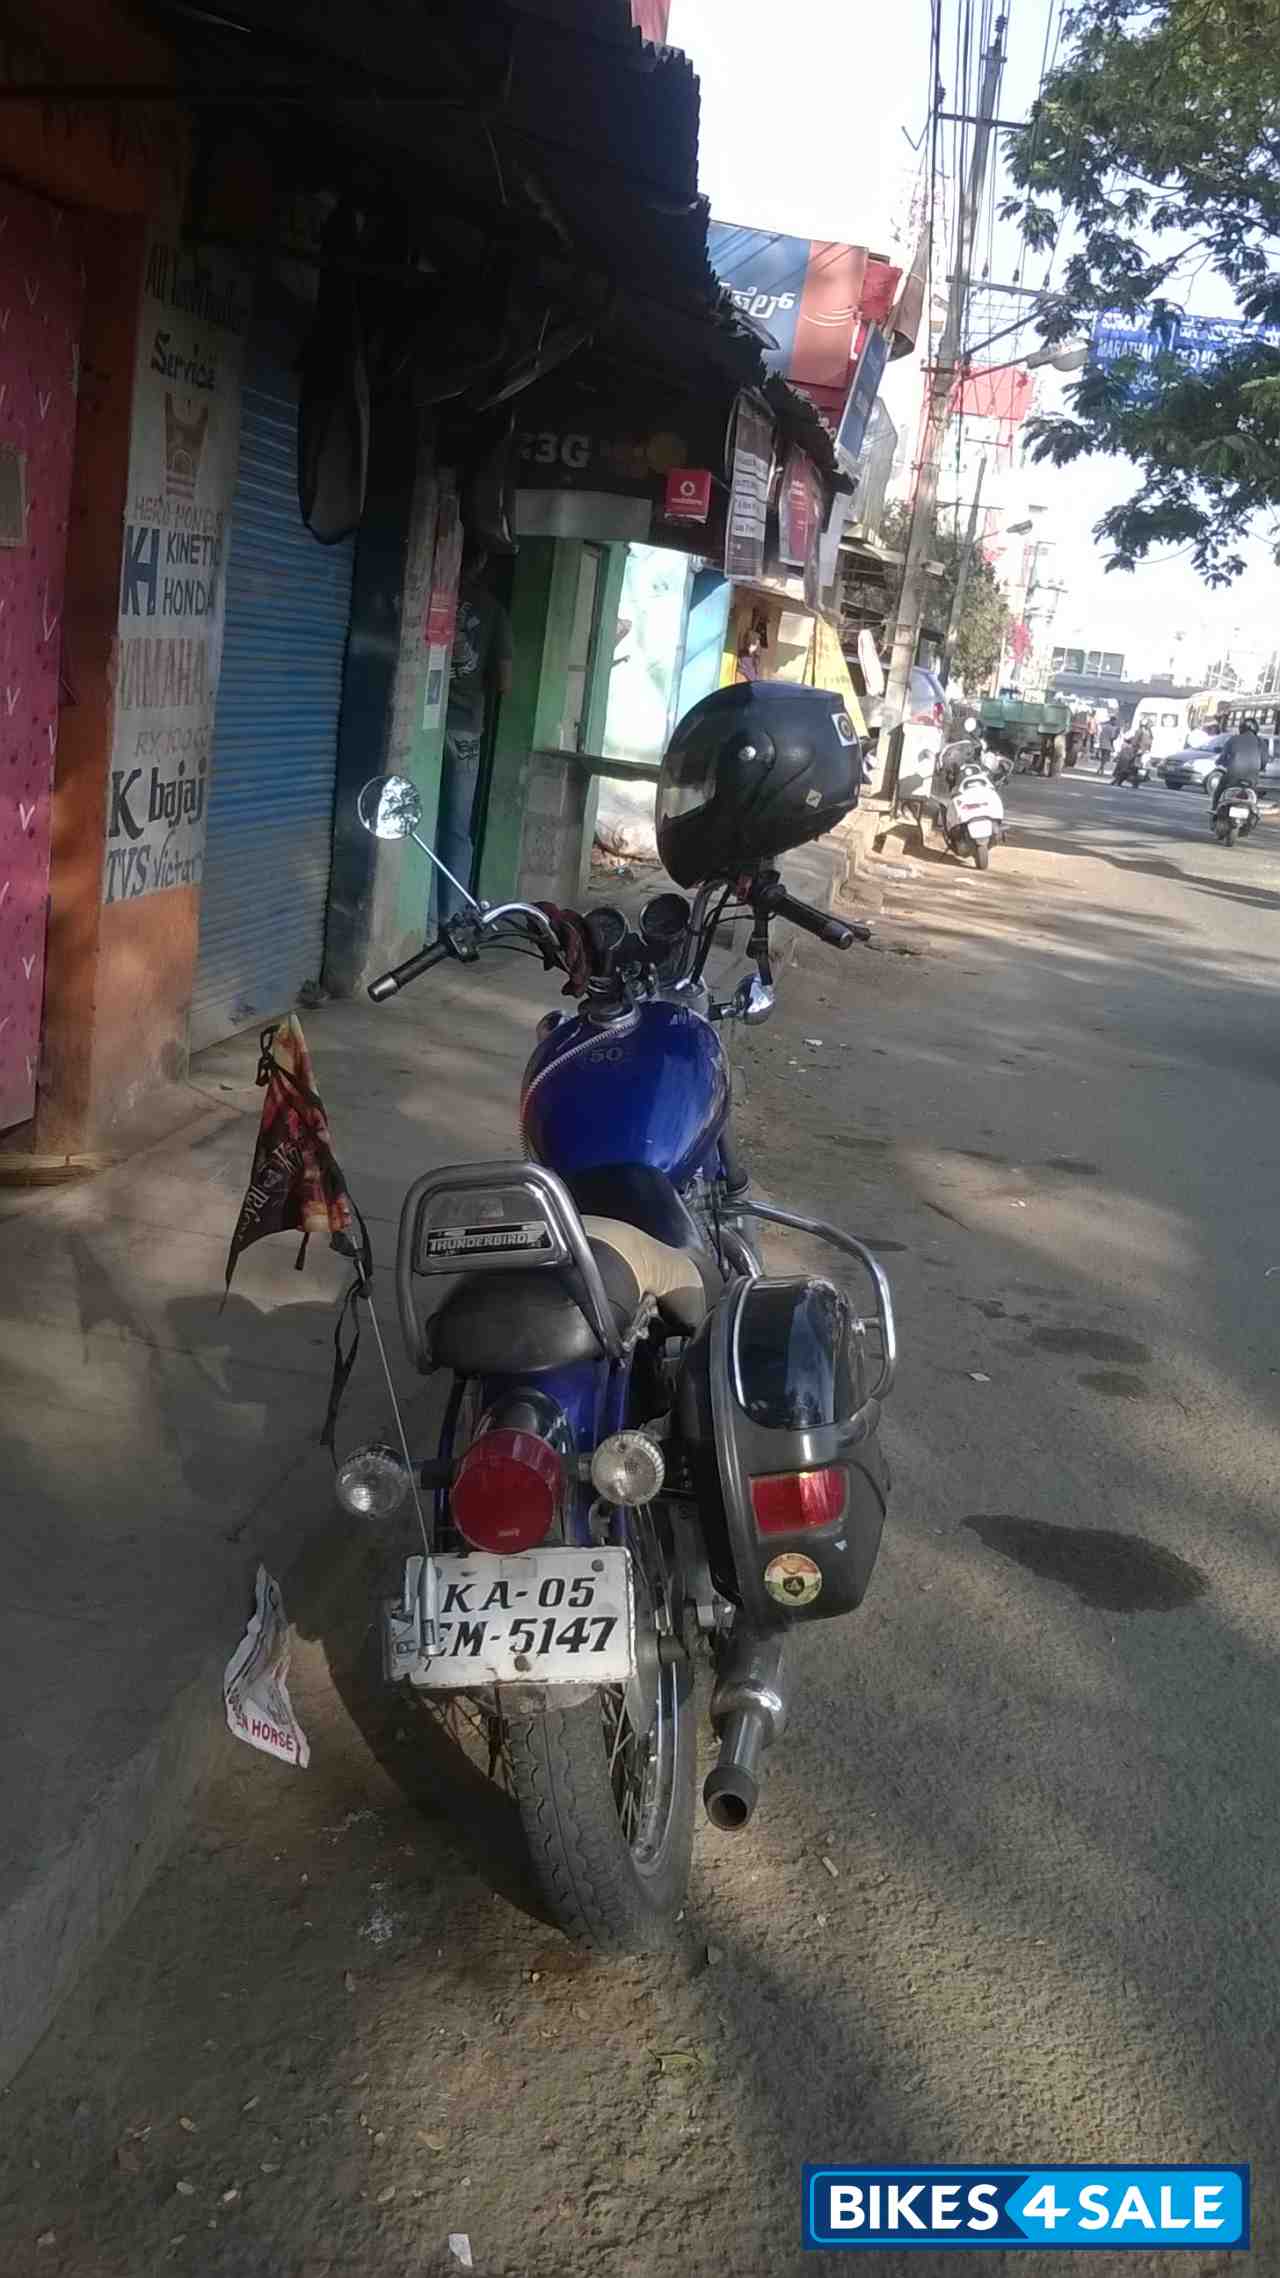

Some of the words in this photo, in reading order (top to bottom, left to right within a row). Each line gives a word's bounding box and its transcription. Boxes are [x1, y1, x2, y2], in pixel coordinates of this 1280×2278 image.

[162, 577, 216, 617] HONDA
[148, 757, 207, 828] bajaj
[105, 845, 151, 904] TVS
[429, 1232, 529, 1252] THUNDERBIRD
[251, 1719, 294, 1751] HORSE
